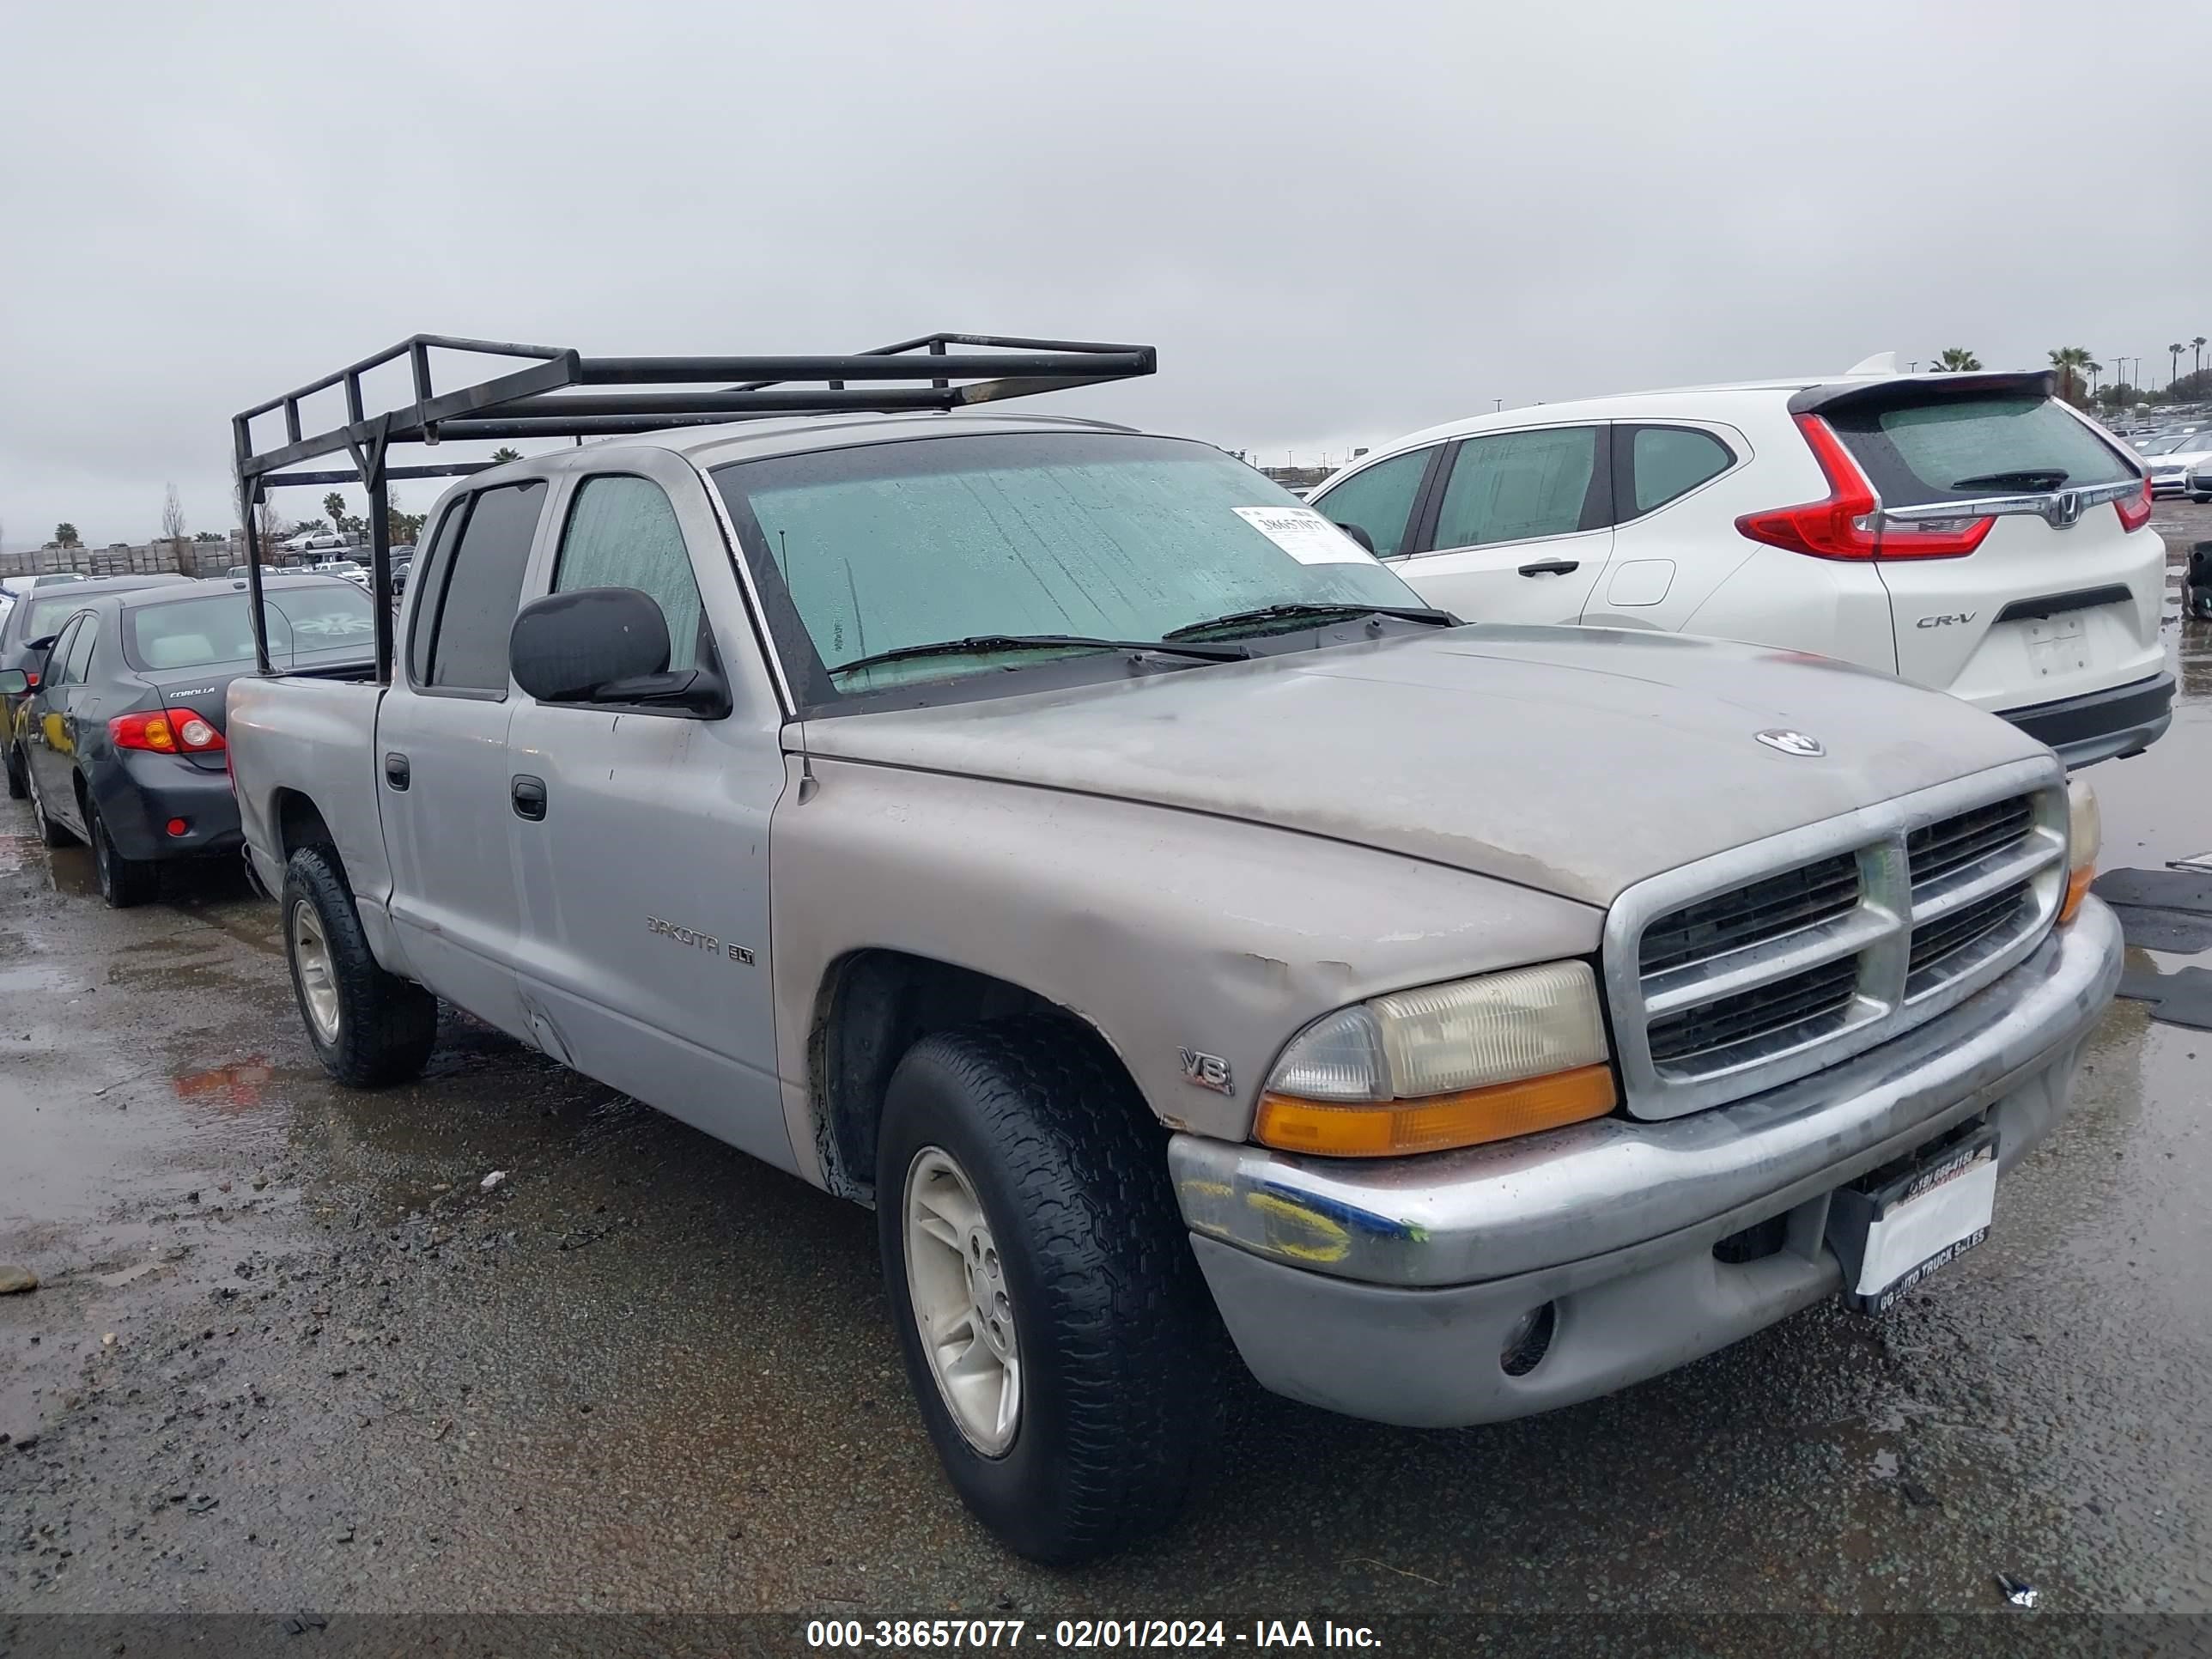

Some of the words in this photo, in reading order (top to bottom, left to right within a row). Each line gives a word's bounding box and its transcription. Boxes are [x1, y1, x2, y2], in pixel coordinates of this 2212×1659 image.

[1917, 611, 1977, 629] CR-V
[170, 687, 216, 698] COROLLA
[647, 915, 720, 956] DAKOTA
[729, 943, 756, 965] SLT
[1176, 1045, 1231, 1085] V8
[1922, 1247, 1953, 1277] TRUCK
